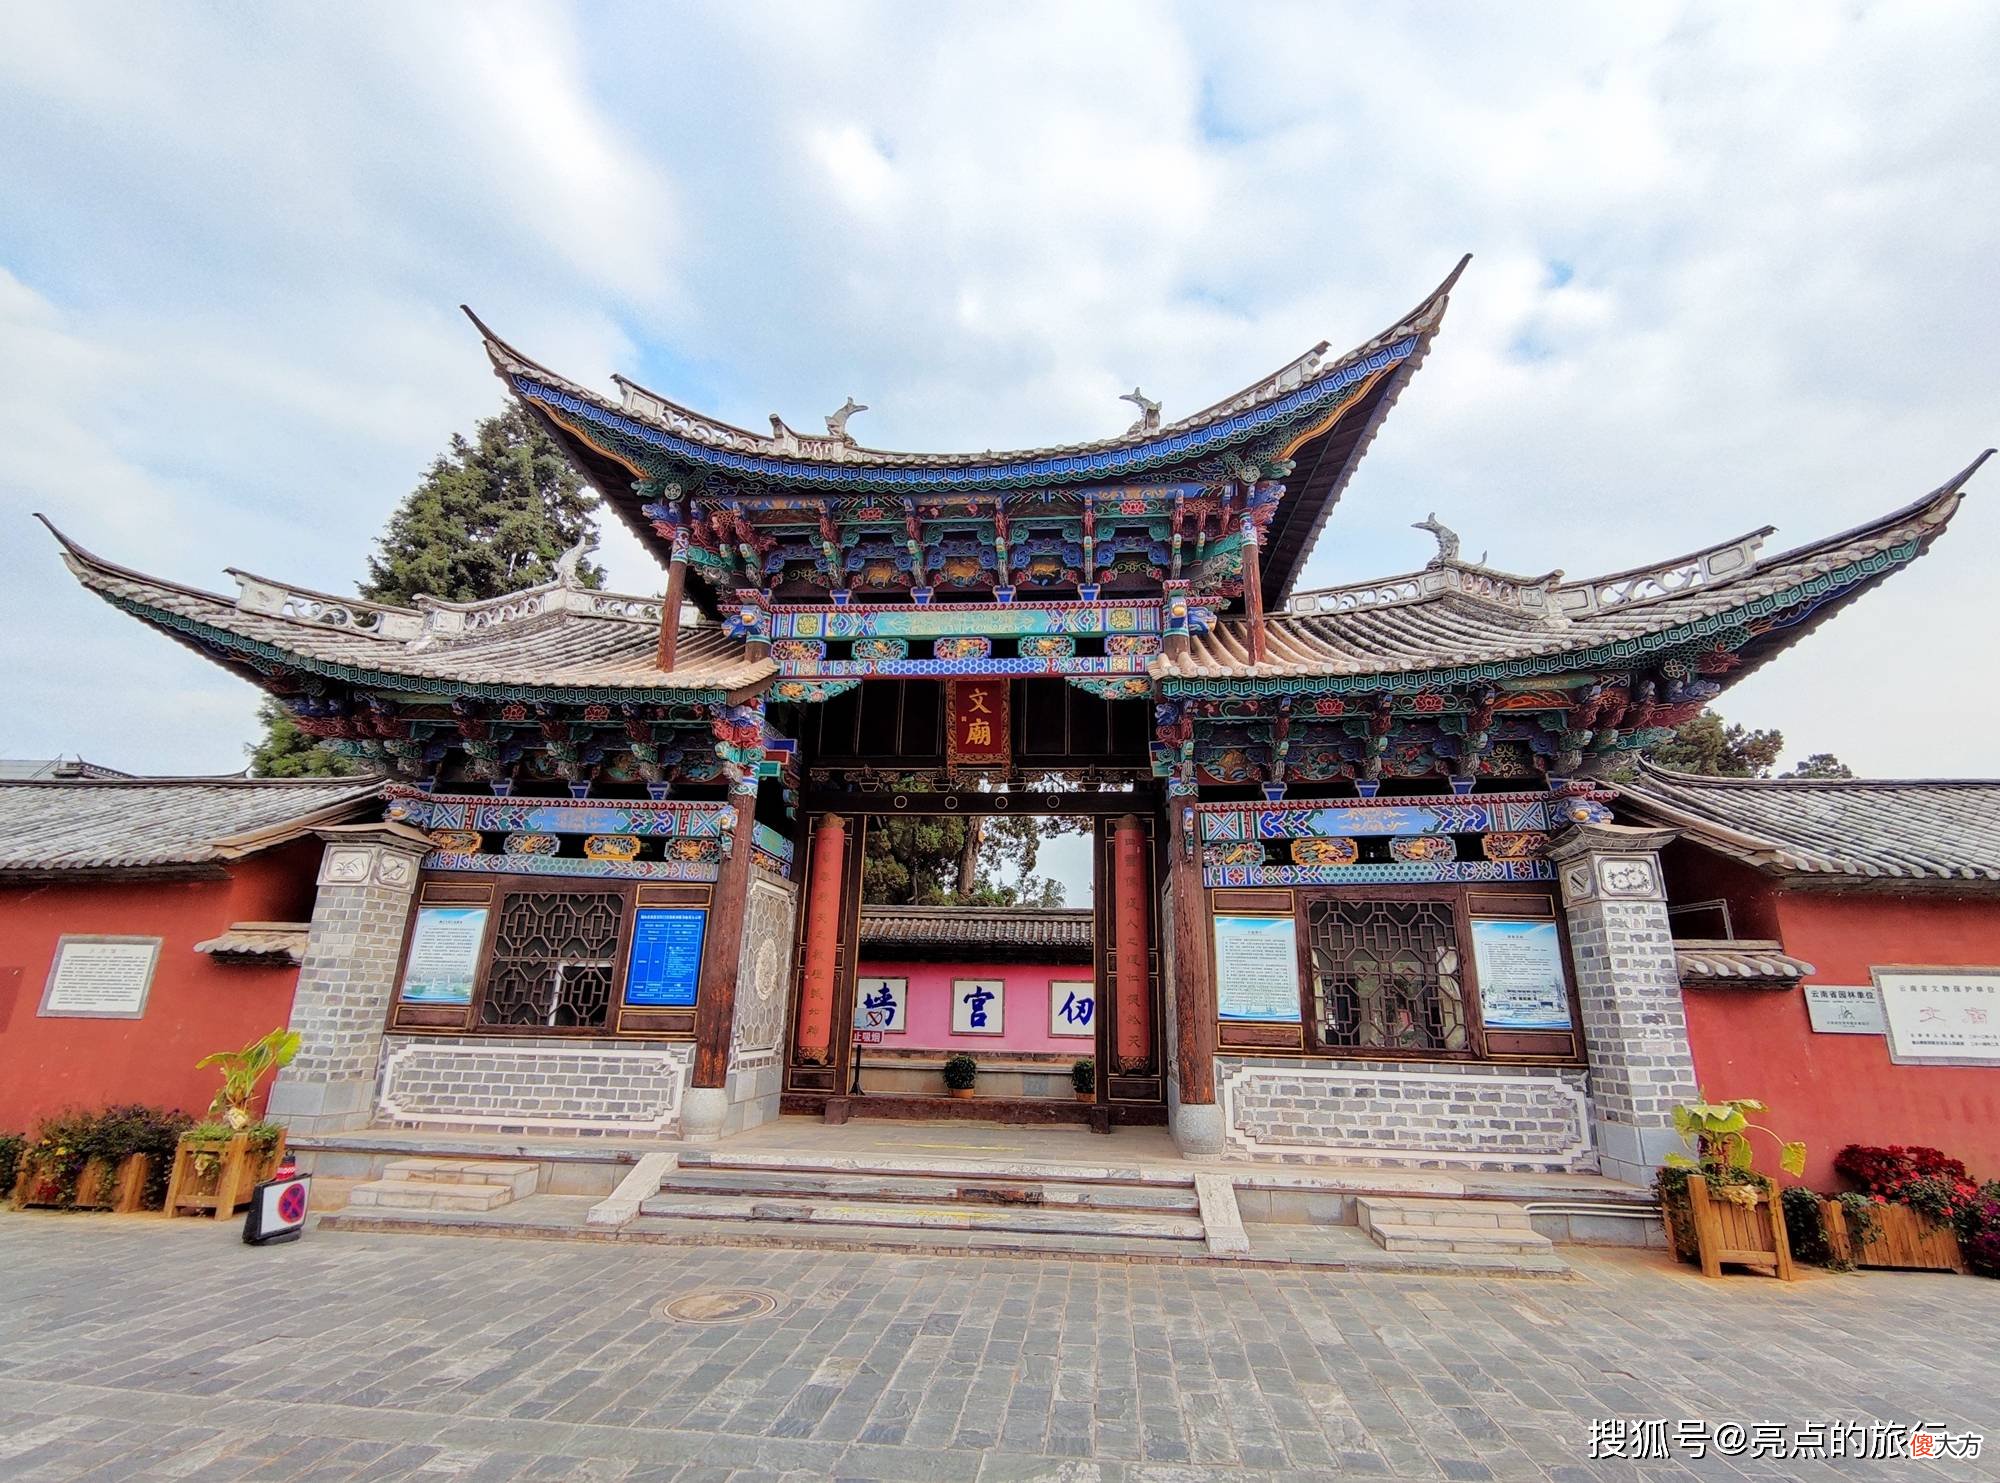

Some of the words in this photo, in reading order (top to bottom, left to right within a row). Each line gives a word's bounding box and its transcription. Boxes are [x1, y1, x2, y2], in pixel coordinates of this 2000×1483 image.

[965, 688, 992, 746] 文廟
[1811, 989, 1875, 999] 云南省园林单位
[1899, 985, 1995, 993] 云南省文物保护单位
